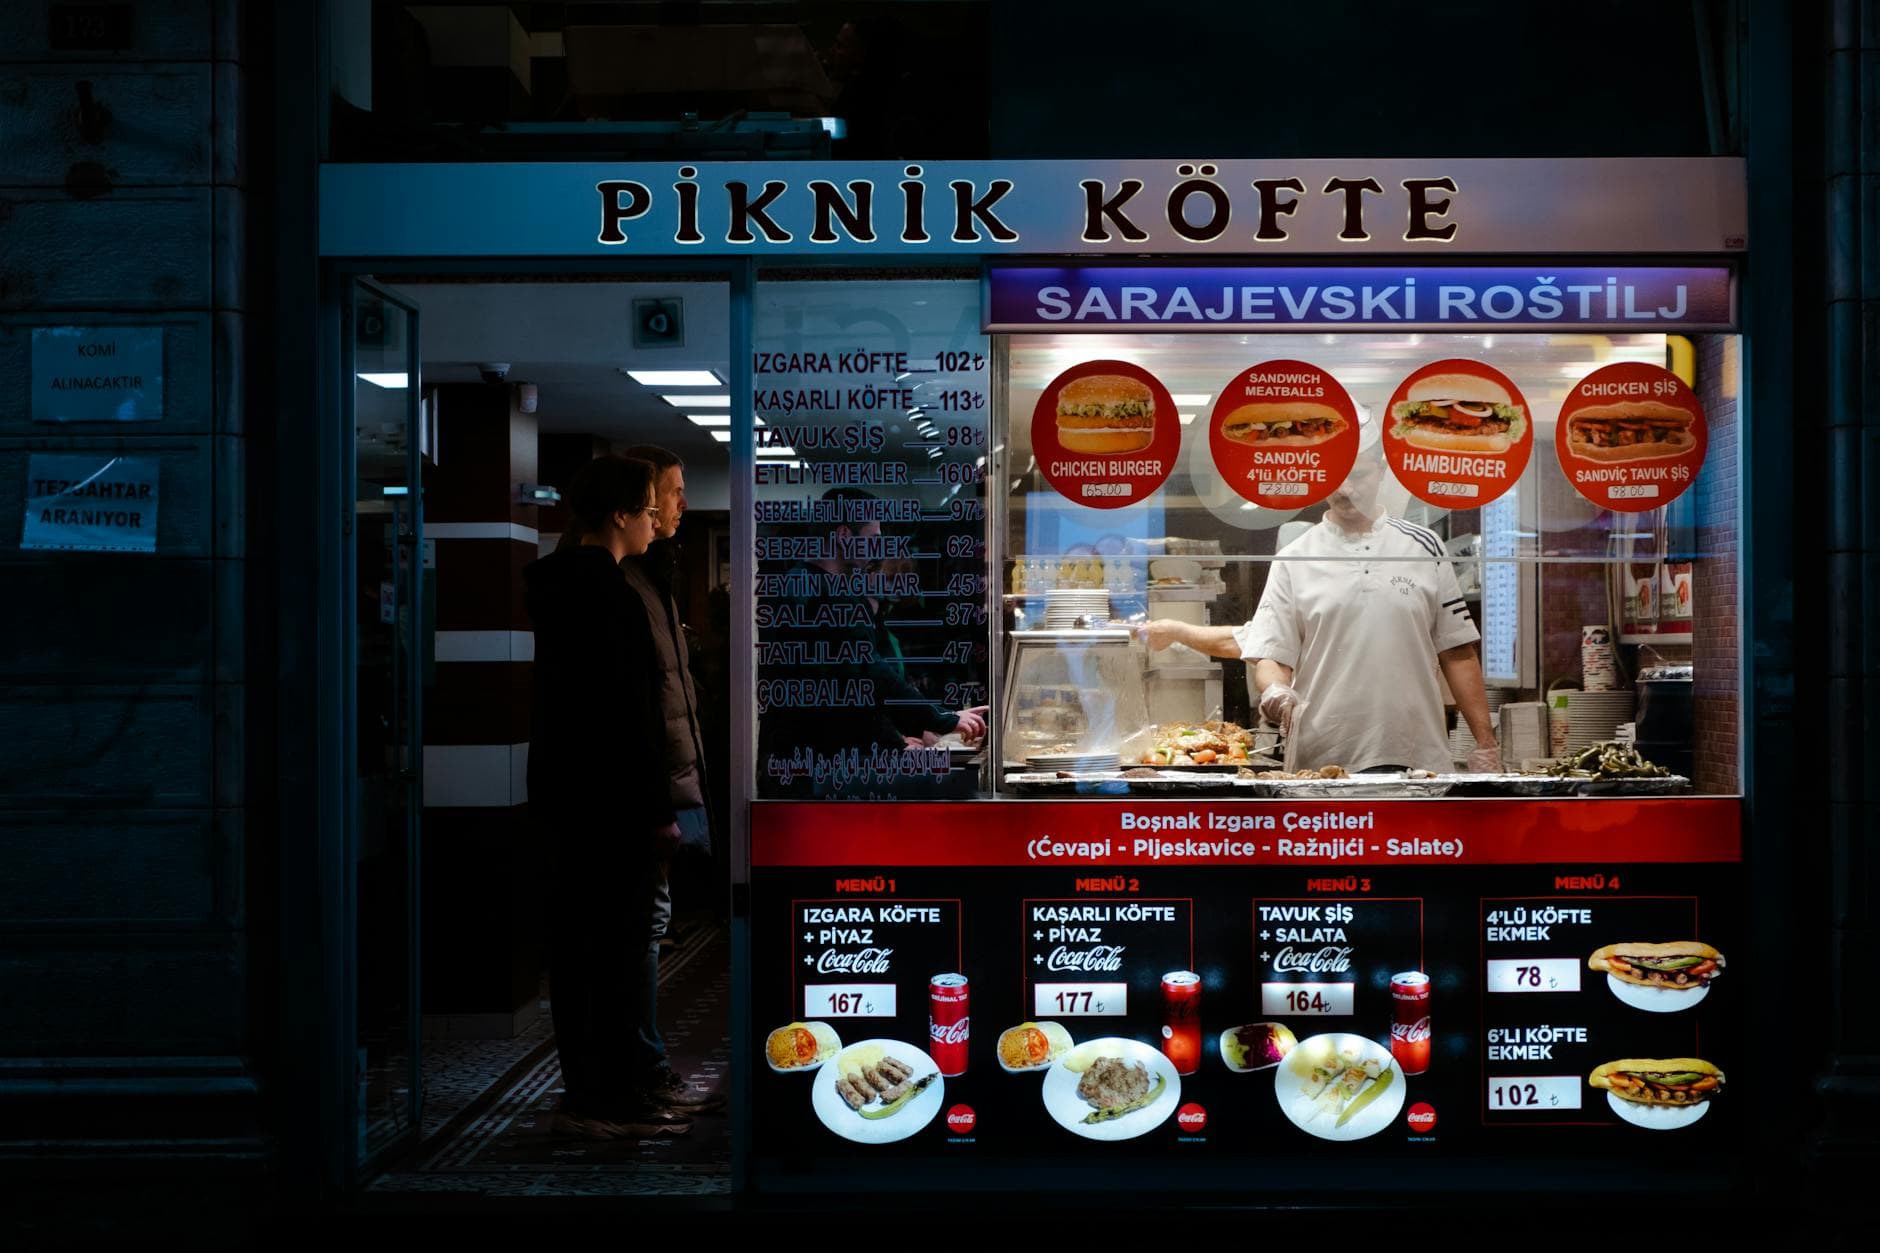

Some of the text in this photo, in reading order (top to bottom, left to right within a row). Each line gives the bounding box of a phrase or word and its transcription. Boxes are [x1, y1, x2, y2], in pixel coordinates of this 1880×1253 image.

[596, 162, 1460, 245] PİKNİK KÖFTE
[1035, 275, 1690, 322] SARAJEVSKİ ROŠTİLJ
[77, 340, 116, 357] KOMİ
[753, 352, 832, 373] IZGARA
[839, 349, 908, 373] KÖFTE
[51, 376, 143, 391] ALINACAKTIR
[1249, 373, 1321, 385] SANDWICH
[1581, 378, 1678, 397] CHICKEN ŞİŞ
[754, 389, 840, 415] KAŞARLI
[848, 384, 913, 410] KÖFTE
[1245, 385, 1324, 398] MEATBALLS
[753, 427, 839, 449] TAVUK
[844, 421, 885, 453] ŞİŞ
[1051, 460, 1162, 478] CHICKEN BURGER
[1253, 450, 1321, 468] SANDVİÇ
[1403, 453, 1507, 479] HAMBURGER
[754, 458, 805, 485] ETLİ
[809, 462, 908, 485] YEMEKLER
[1275, 467, 1327, 483] KÖFTE
[1576, 463, 1690, 483] SANDVİÇ TAVUK ŞİŞ
[34, 480, 151, 499] TEZGAHTAR
[40, 508, 141, 528] ARANIYOR
[754, 496, 812, 522] SEBZELİ
[844, 499, 921, 522] YEMEKLER
[755, 532, 837, 560] SEBZELİ
[841, 536, 911, 560] YEMEK
[755, 569, 822, 597] ZEYTİN
[824, 568, 920, 597] YAĞLILAR
[755, 603, 874, 627] SALATA
[755, 641, 875, 665] TATLILAR
[756, 679, 876, 714] ÇORBALAR
[1121, 811, 1374, 833] Boşnak Izgara Çeşitleri
[1027, 836, 1111, 862] (Ćevapi
[1133, 837, 1255, 859] Pljeskavice
[1277, 837, 1364, 860] Ražnjići
[1386, 838, 1464, 859] Salate)
[836, 876, 896, 892] MENÜ 1
[1076, 876, 1140, 892] MENÜ 2
[1307, 876, 1371, 892] MENÜ 3
[1555, 874, 1621, 890] MENÜ 4
[803, 905, 940, 923] IZGARA KÖFTE
[1033, 904, 1175, 924] KAŞARLI KÖFTE
[1259, 903, 1353, 924] TAVUK ŞİŞ
[1532, 906, 1592, 924] KÖFTE
[804, 927, 873, 944] + PİYAZ
[1033, 925, 1101, 942] + PİYAZ
[1260, 928, 1347, 943] + SALATA
[1487, 926, 1551, 941] EKMEK
[804, 948, 894, 974] + Coca-Cola
[1033, 945, 1126, 972] + Coca-Cola
[1260, 946, 1354, 973] + Coca-Cola
[1516, 966, 1542, 987] 78
[828, 993, 863, 1014] 167
[1055, 991, 1093, 1013] 177
[1525, 1025, 1588, 1043] KÖFTE
[1487, 1045, 1553, 1061] EKMEK
[1494, 1084, 1539, 1106] 102
